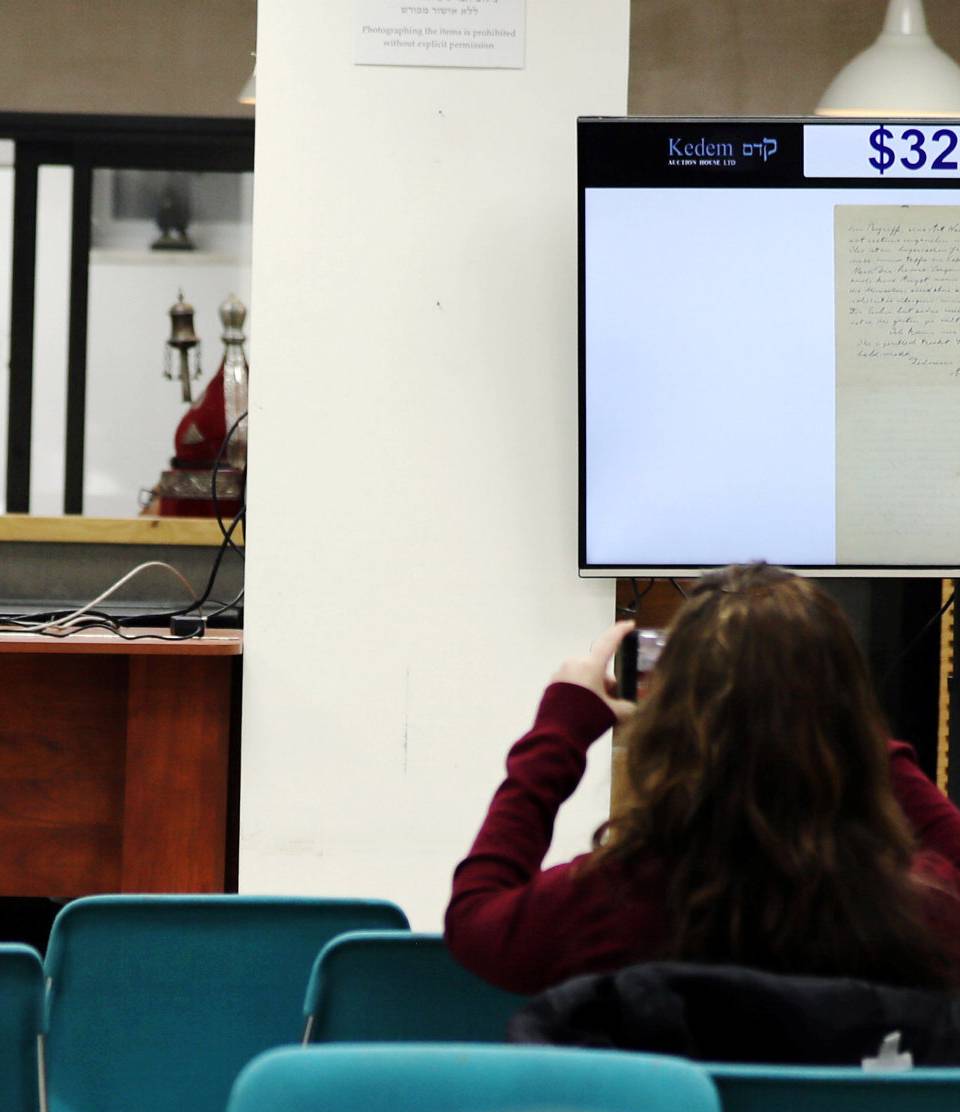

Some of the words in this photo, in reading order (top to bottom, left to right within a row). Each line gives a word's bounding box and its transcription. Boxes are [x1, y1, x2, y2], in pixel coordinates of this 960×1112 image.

[362, 25, 423, 37] Photographing
[424, 26, 438, 36] the
[439, 27, 463, 37] items
[472, 27, 517, 38] prohibited
[383, 39, 416, 49] without
[417, 40, 448, 51] explicit
[449, 41, 495, 51] permission
[669, 138, 733, 156] Kedem
[742, 138, 777, 162] קדם
